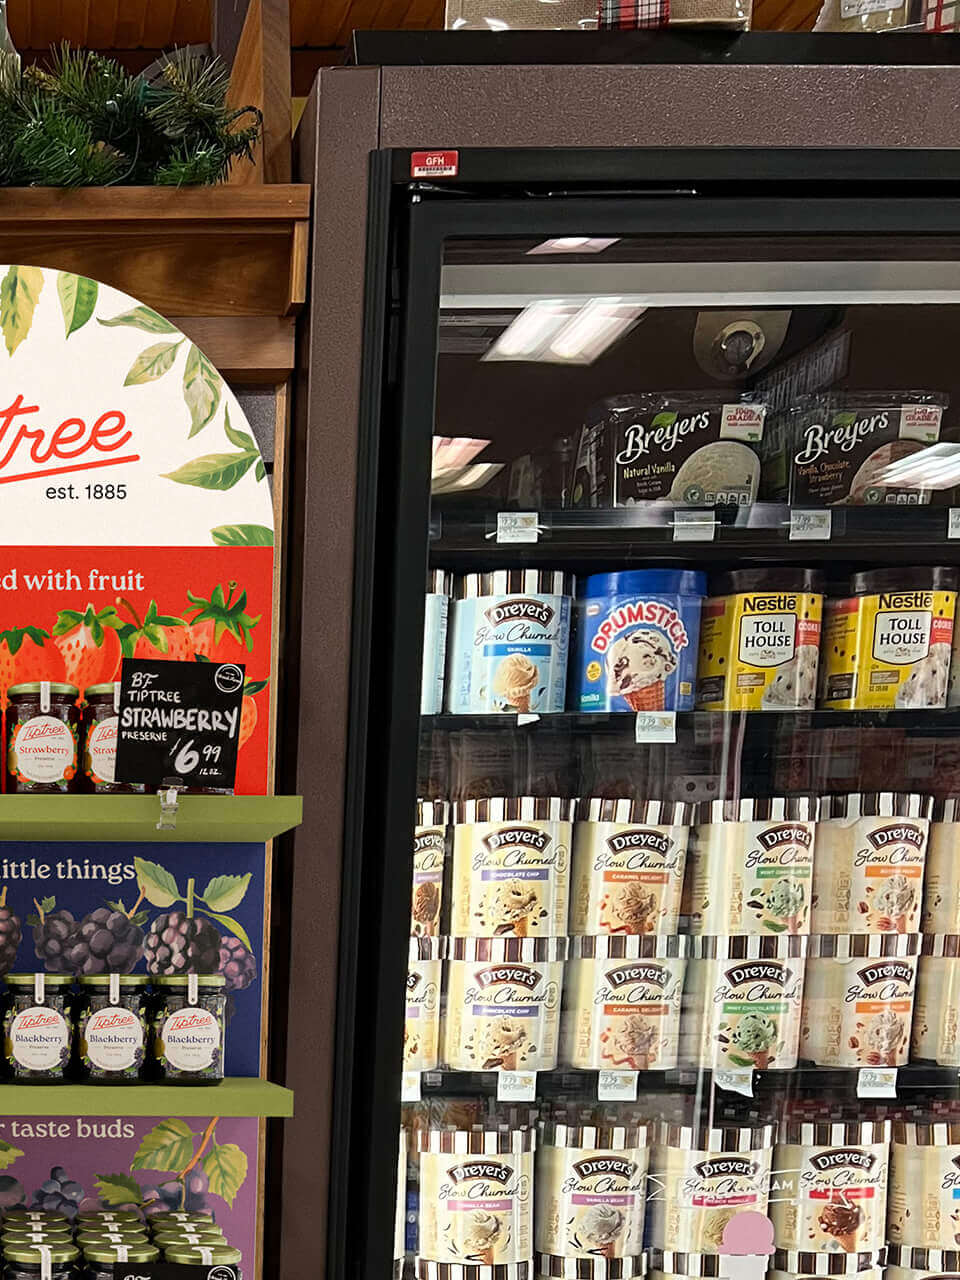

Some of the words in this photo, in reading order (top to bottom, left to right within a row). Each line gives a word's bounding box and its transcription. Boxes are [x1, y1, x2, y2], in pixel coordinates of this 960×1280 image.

[616, 411, 710, 465] Breyers
[795, 412, 889, 465] Breyers
[623, 464, 651, 480] Natural
[652, 462, 676, 477] Vanilla
[45, 485, 78, 500] est.
[84, 484, 128, 500] 1885
[23, 569, 83, 591] with
[88, 569, 144, 592] fruit
[493, 601, 551, 624] Dreyer's
[753, 621, 786, 634] TOLL
[745, 635, 791, 648] HOUSE
[127, 690, 181, 703] TIPTREE
[121, 706, 239, 739] STRAWBERRY
[22, 723, 66, 742] Tiptree
[122, 731, 168, 742] PRESERVE
[19, 745, 70, 756] Strawberry
[488, 828, 545, 849] Dreyer's
[610, 830, 669, 852] Dreyer's
[56, 858, 136, 885] things
[17, 1014, 60, 1030] Tiptree
[170, 1015, 213, 1031] Tiptree
[15, 1034, 63, 1045] Blackberry
[167, 1035, 216, 1046] Blackberry
[11, 1118, 71, 1138] taste
[76, 1117, 136, 1139] buds
[817, 1150, 873, 1171] Dreyer's
[453, 1161, 508, 1180] Dreyer's
